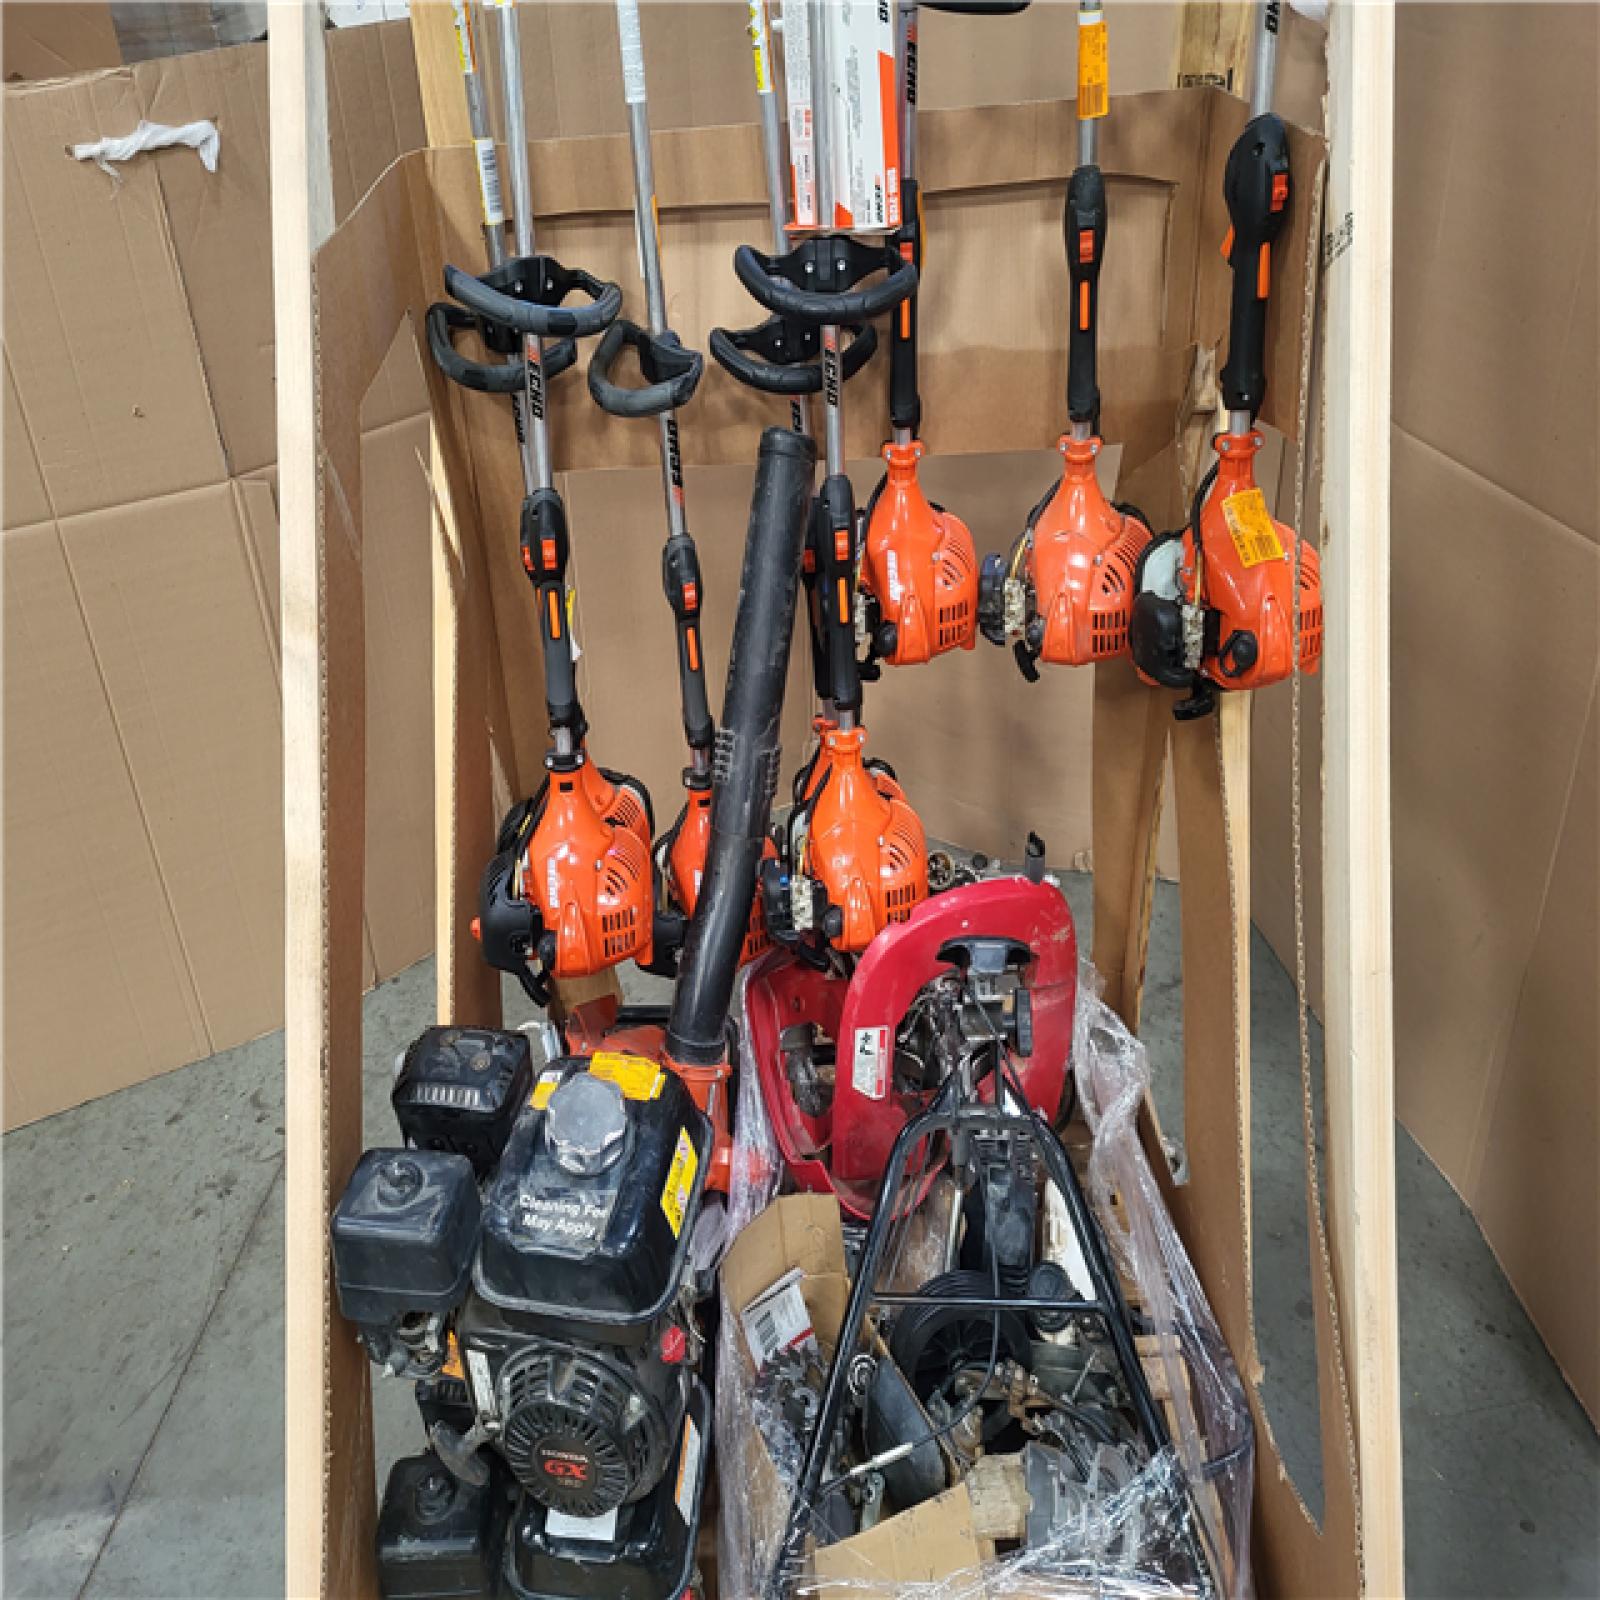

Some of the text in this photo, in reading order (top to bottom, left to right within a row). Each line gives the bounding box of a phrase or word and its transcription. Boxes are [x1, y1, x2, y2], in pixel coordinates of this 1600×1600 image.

[907, 41, 918, 105] ECHO
[528, 361, 543, 420] ECHO
[825, 349, 838, 407] ECHO
[668, 420, 683, 487] ECHO
[520, 1193, 583, 1219] Cleaning
[522, 1213, 596, 1239] May Apply
[544, 1460, 588, 1479] GX
